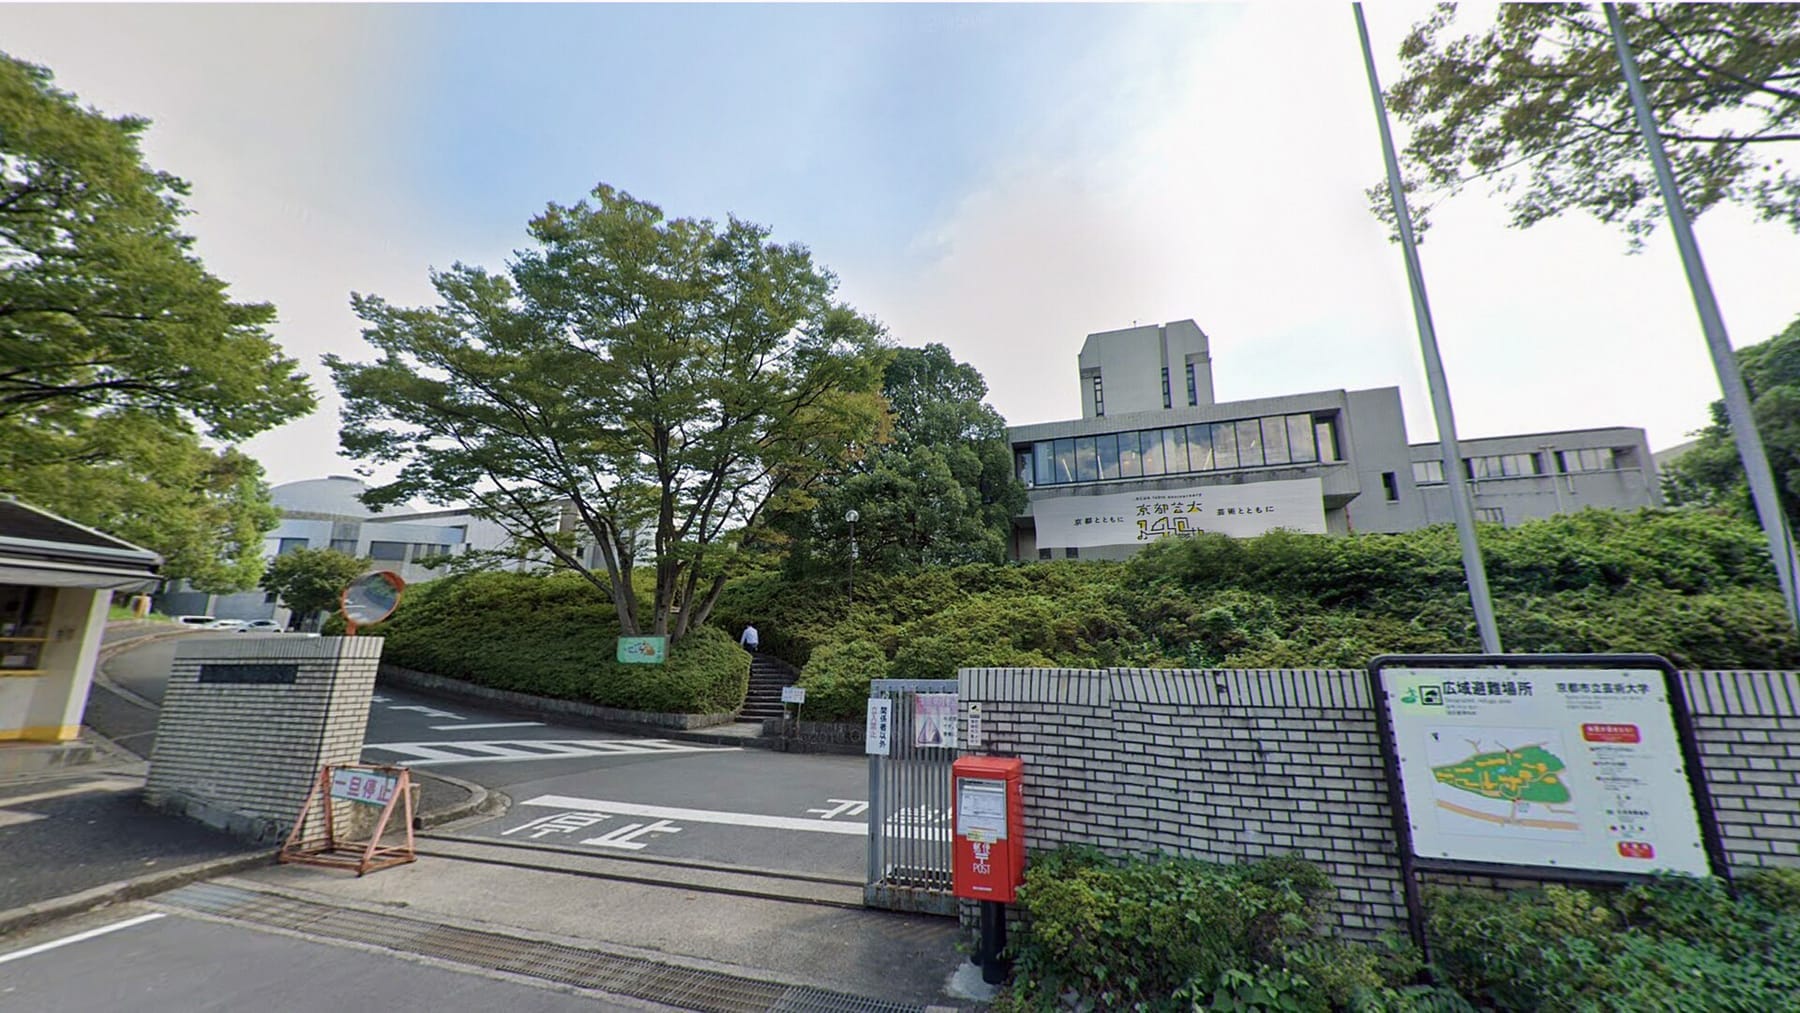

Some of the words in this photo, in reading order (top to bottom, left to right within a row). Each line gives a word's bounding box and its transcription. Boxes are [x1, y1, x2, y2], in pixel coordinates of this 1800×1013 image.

[1442, 681, 1533, 696] 広域避難場所
[335, 775, 393, 803] 一旦停止
[501, 811, 682, 850] 停止
[973, 862, 991, 874] POST
